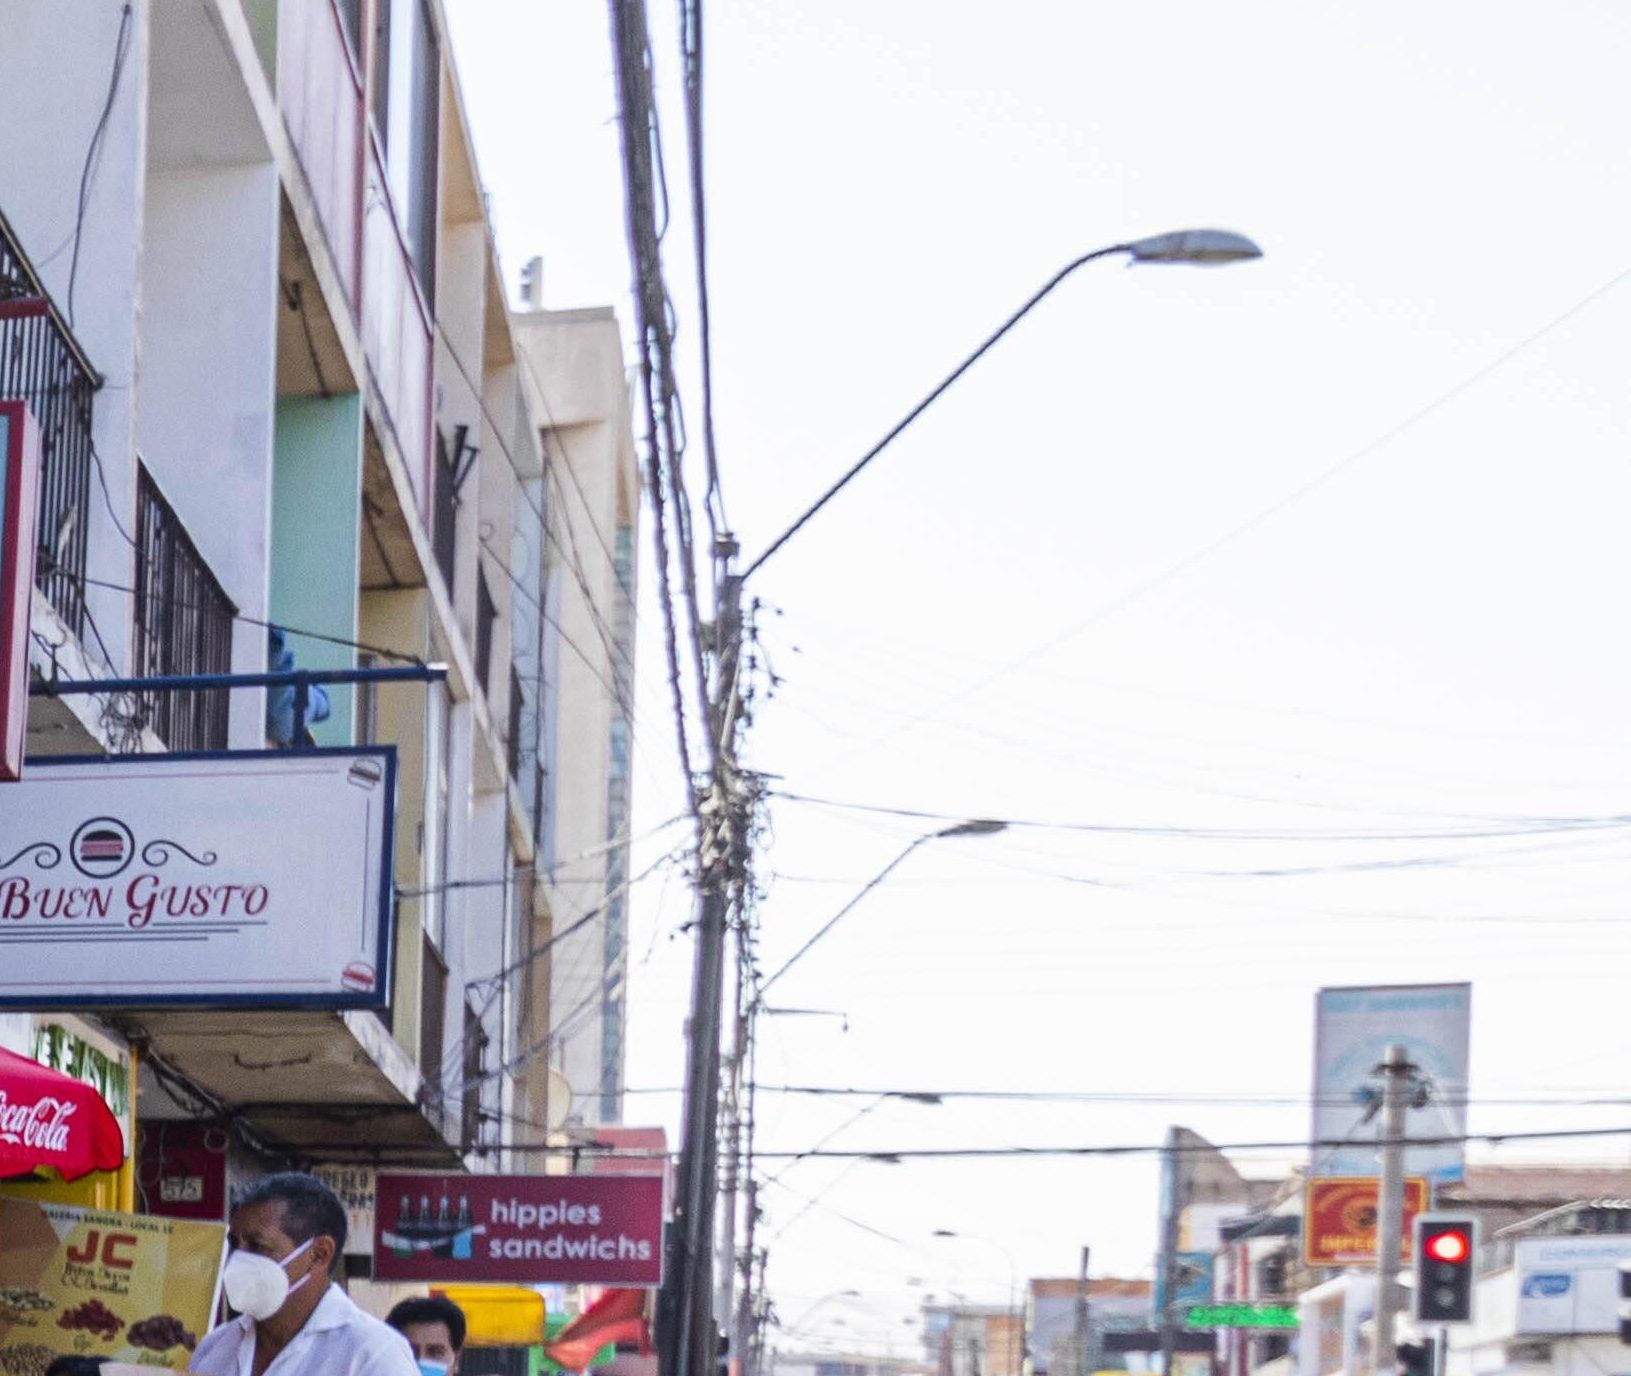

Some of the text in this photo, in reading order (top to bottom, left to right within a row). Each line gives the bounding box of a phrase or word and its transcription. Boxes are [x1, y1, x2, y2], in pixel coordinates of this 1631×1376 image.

[124, 873, 271, 929] GUSTO
[489, 1197, 603, 1230] hippies
[66, 1229, 138, 1270] JC
[488, 1234, 653, 1262] sandwichs
